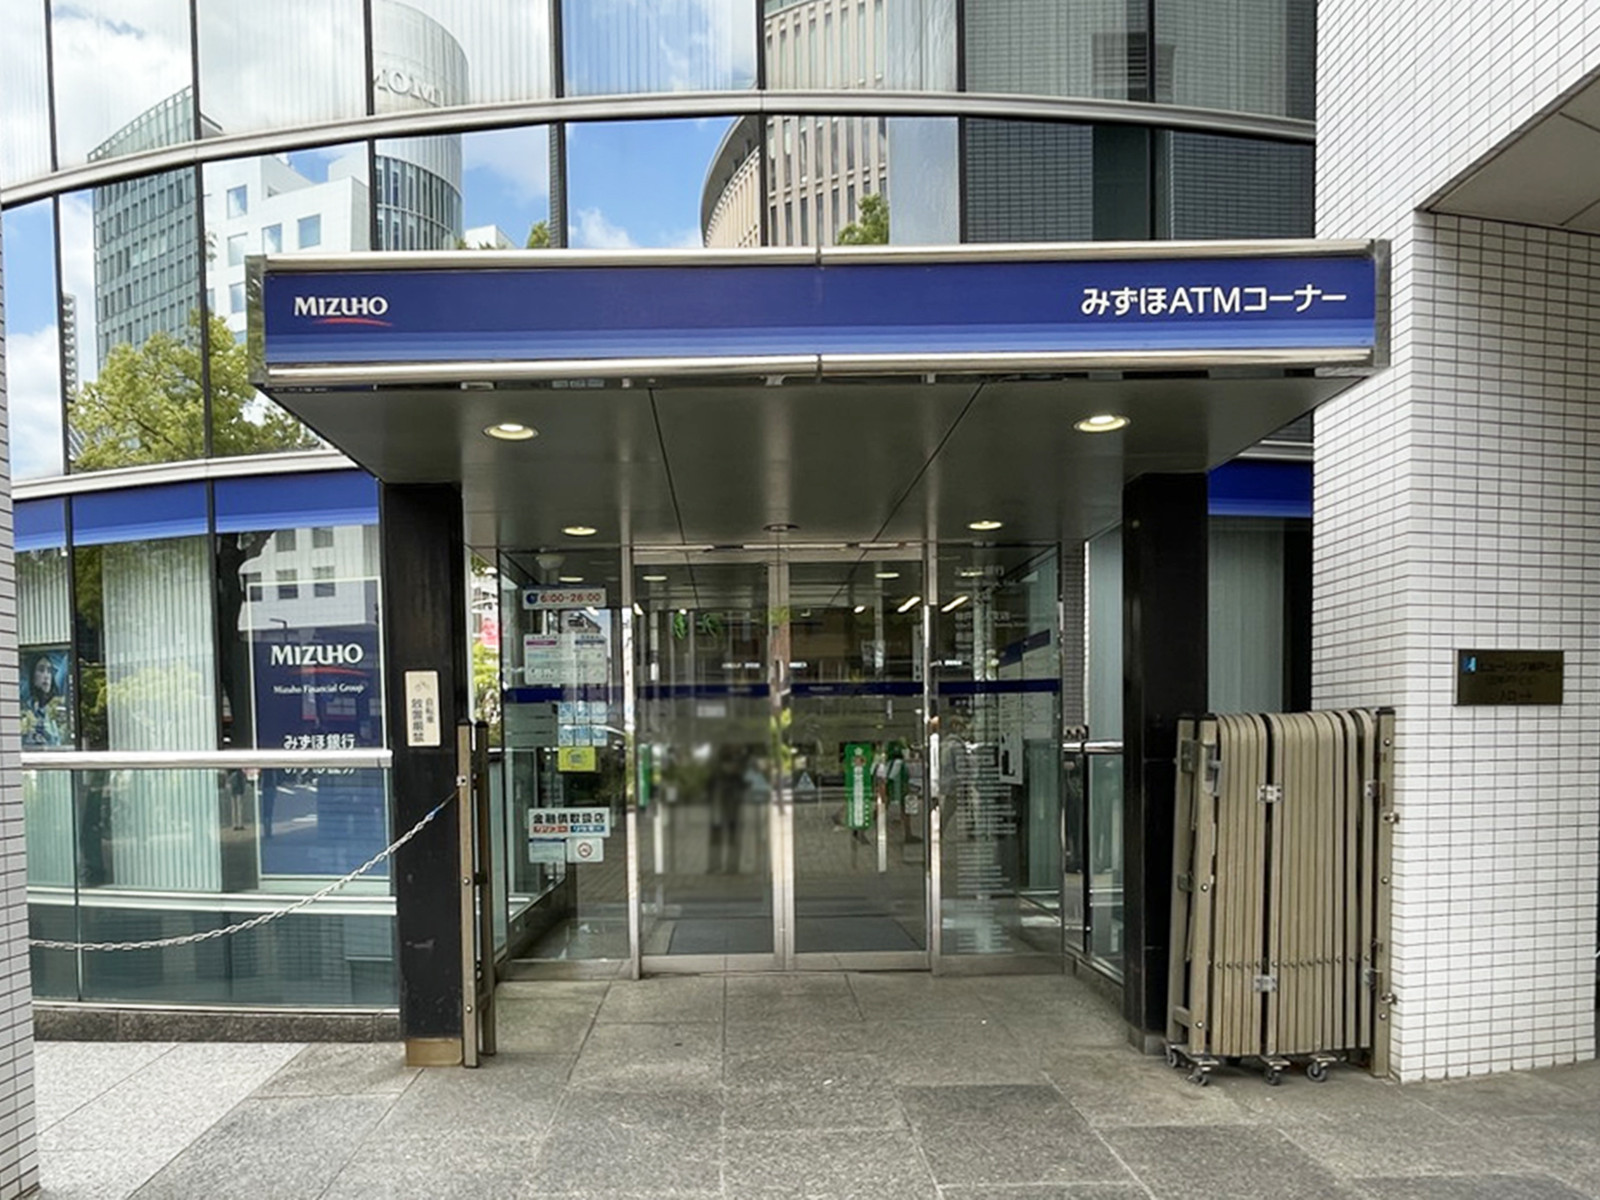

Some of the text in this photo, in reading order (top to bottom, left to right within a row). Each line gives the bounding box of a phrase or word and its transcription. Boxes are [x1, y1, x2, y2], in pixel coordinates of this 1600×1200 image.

[294, 296, 389, 316] MIZUHO
[1081, 284, 1347, 315] みずほATMコーナー
[270, 643, 364, 666] MIZUHO
[273, 683, 364, 694] Mizuho Financial Group
[284, 733, 355, 750] みずほ銀行
